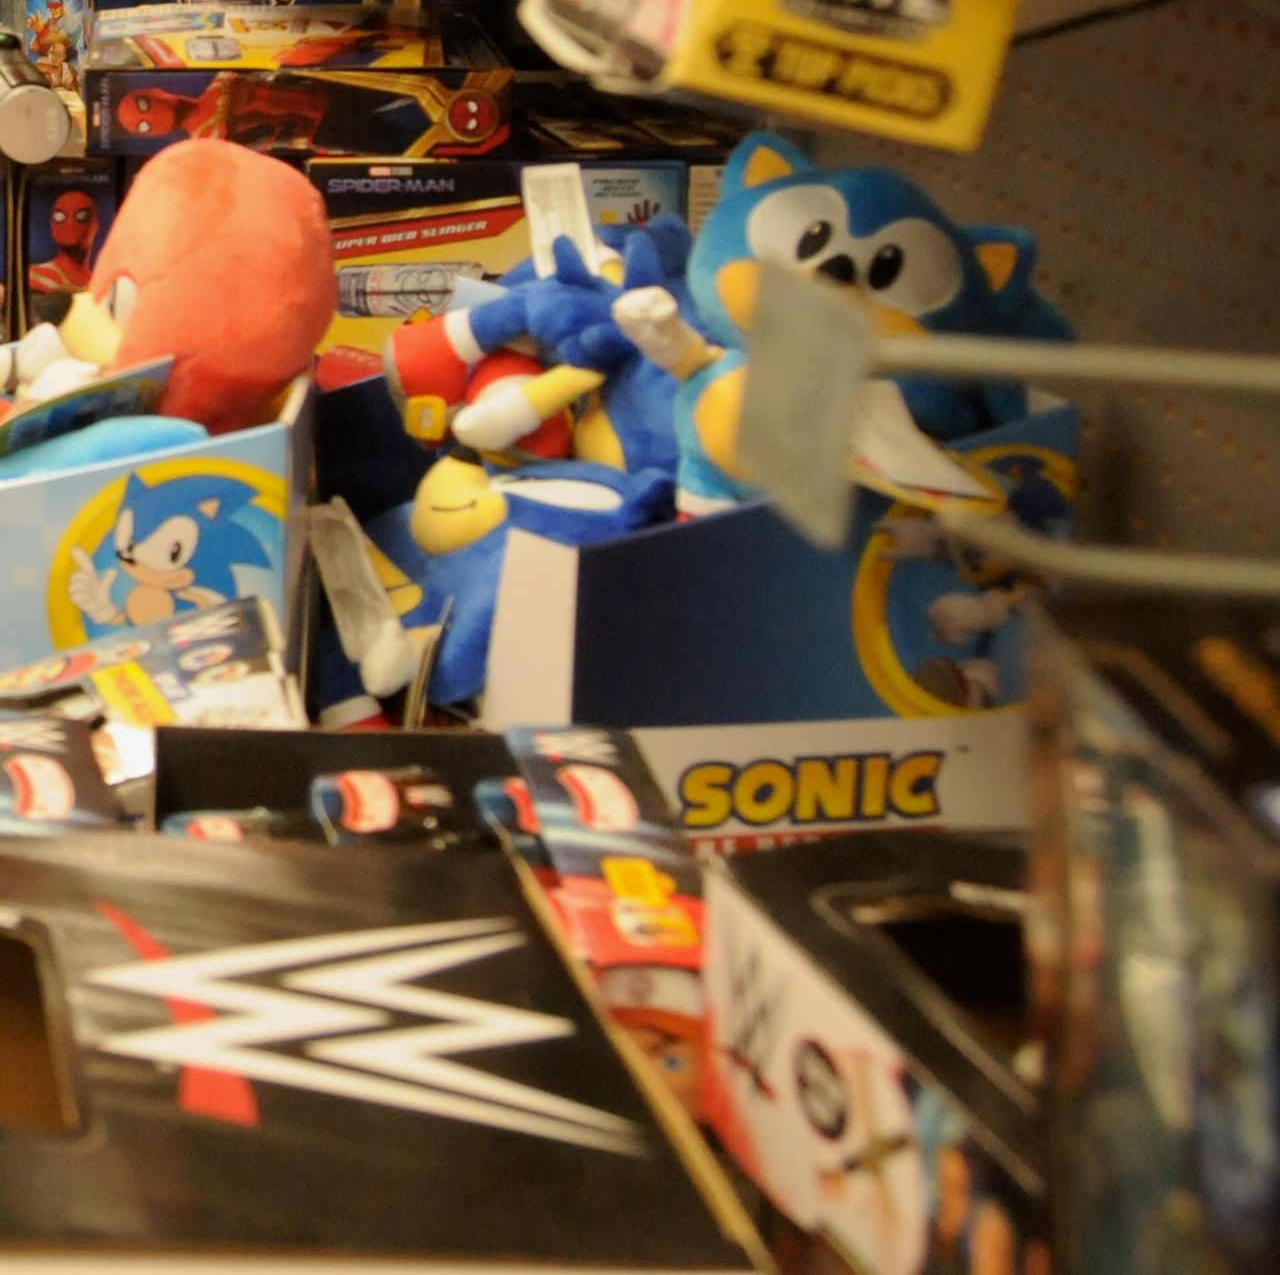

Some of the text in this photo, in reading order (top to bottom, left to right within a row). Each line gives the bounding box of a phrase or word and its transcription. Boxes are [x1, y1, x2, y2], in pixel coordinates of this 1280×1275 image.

[326, 177, 456, 195] SPIDER-MAN
[335, 220, 489, 251] UPER WEB SLINGER
[679, 749, 946, 829] SONIC
